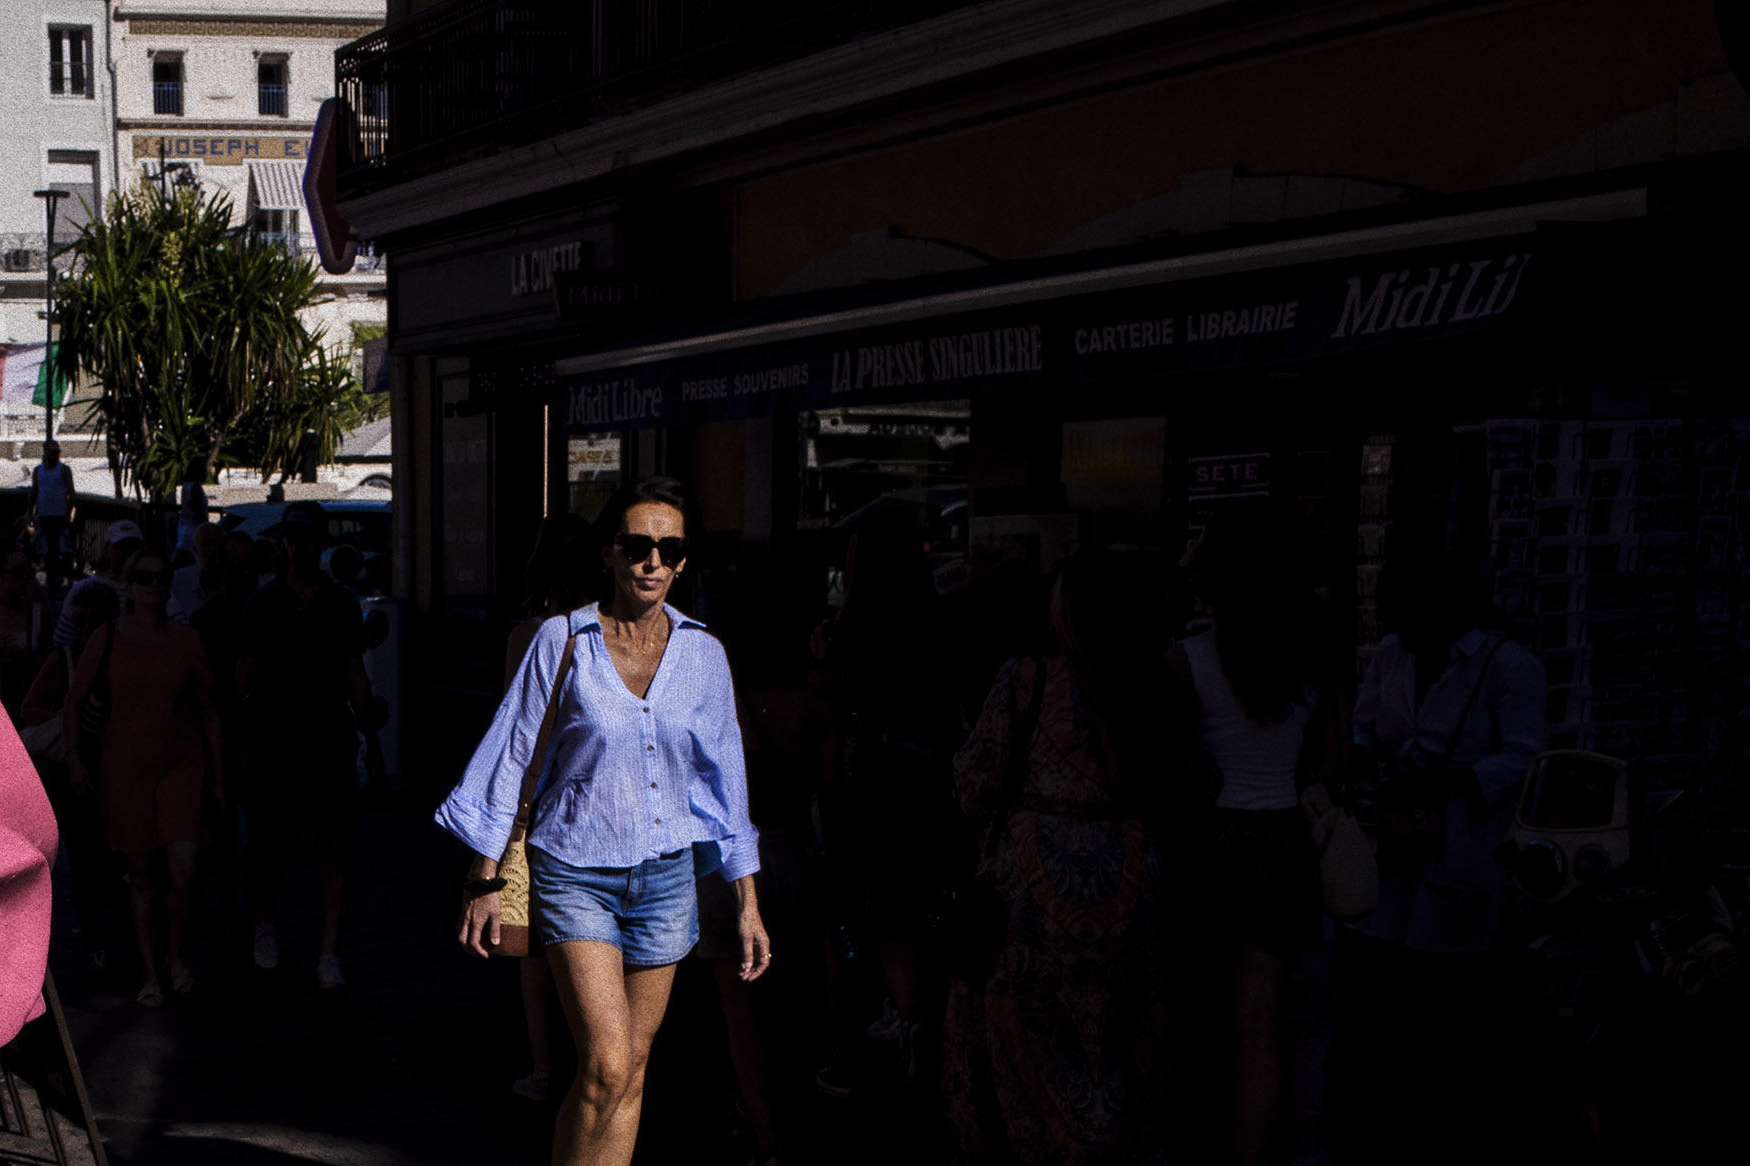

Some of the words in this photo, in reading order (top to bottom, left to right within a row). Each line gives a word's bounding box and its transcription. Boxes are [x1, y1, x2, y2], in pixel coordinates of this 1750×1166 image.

[162, 139, 259, 156] JOSEPH
[511, 254, 529, 296] LA
[1075, 317, 1174, 355] CARTERIE
[1186, 300, 1299, 344] LIBRAIRIE
[681, 377, 728, 401] PRESSE
[733, 363, 810, 396] SOUVENIRS
[832, 350, 851, 393] LA
[855, 341, 926, 389] PRESSE
[1195, 461, 1259, 482] SETE
